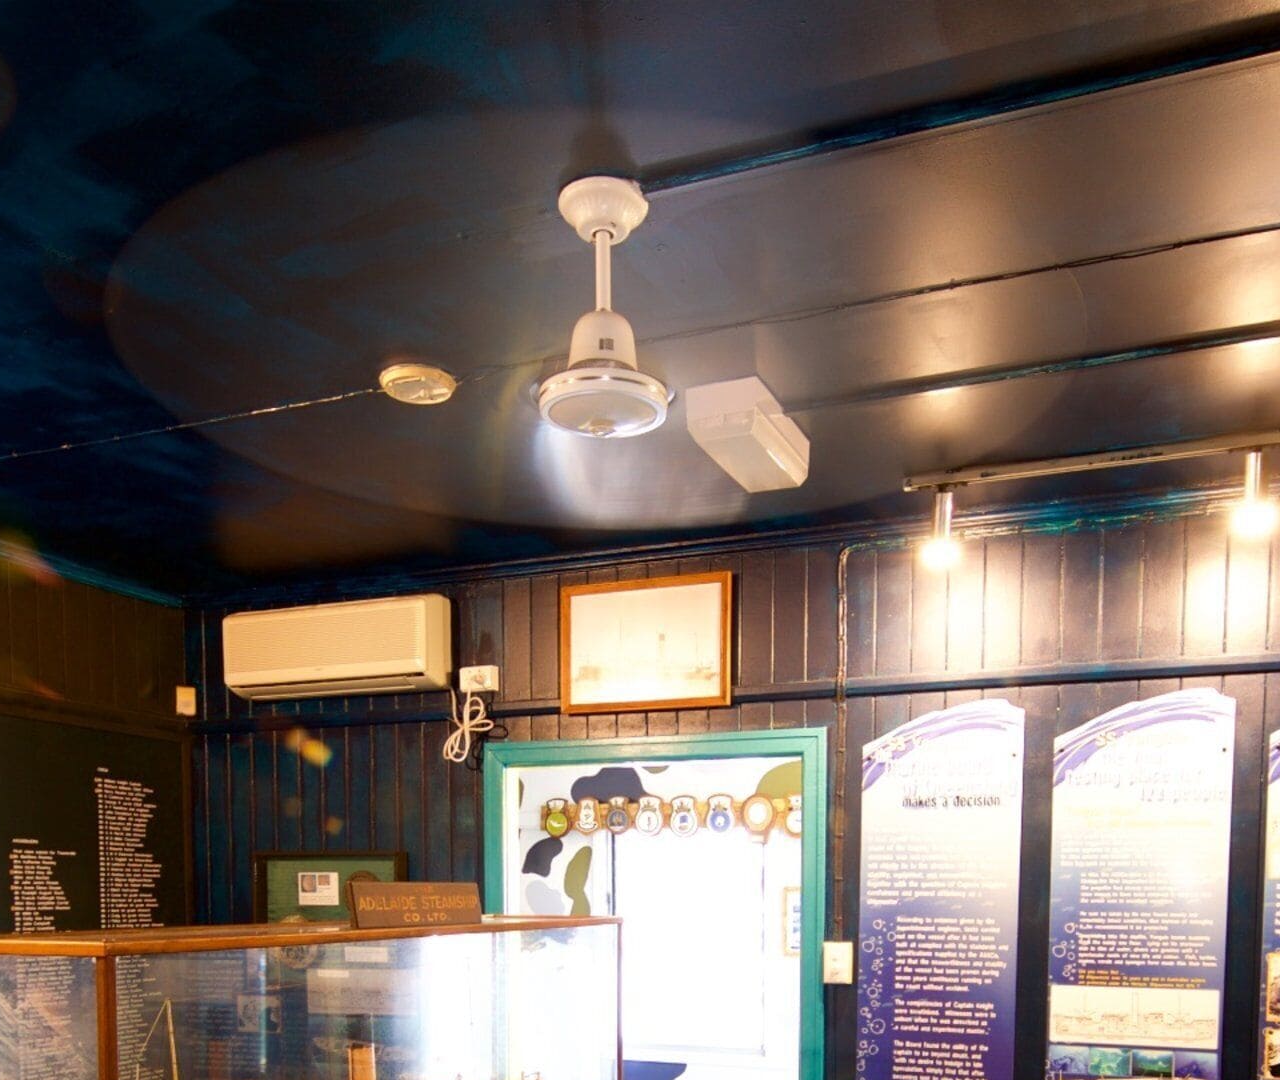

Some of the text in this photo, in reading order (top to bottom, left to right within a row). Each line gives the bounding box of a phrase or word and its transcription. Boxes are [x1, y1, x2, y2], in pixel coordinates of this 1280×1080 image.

[902, 795, 1001, 808] makes a decision
[359, 894, 479, 912] ADELAIDE STEAMSHIP
